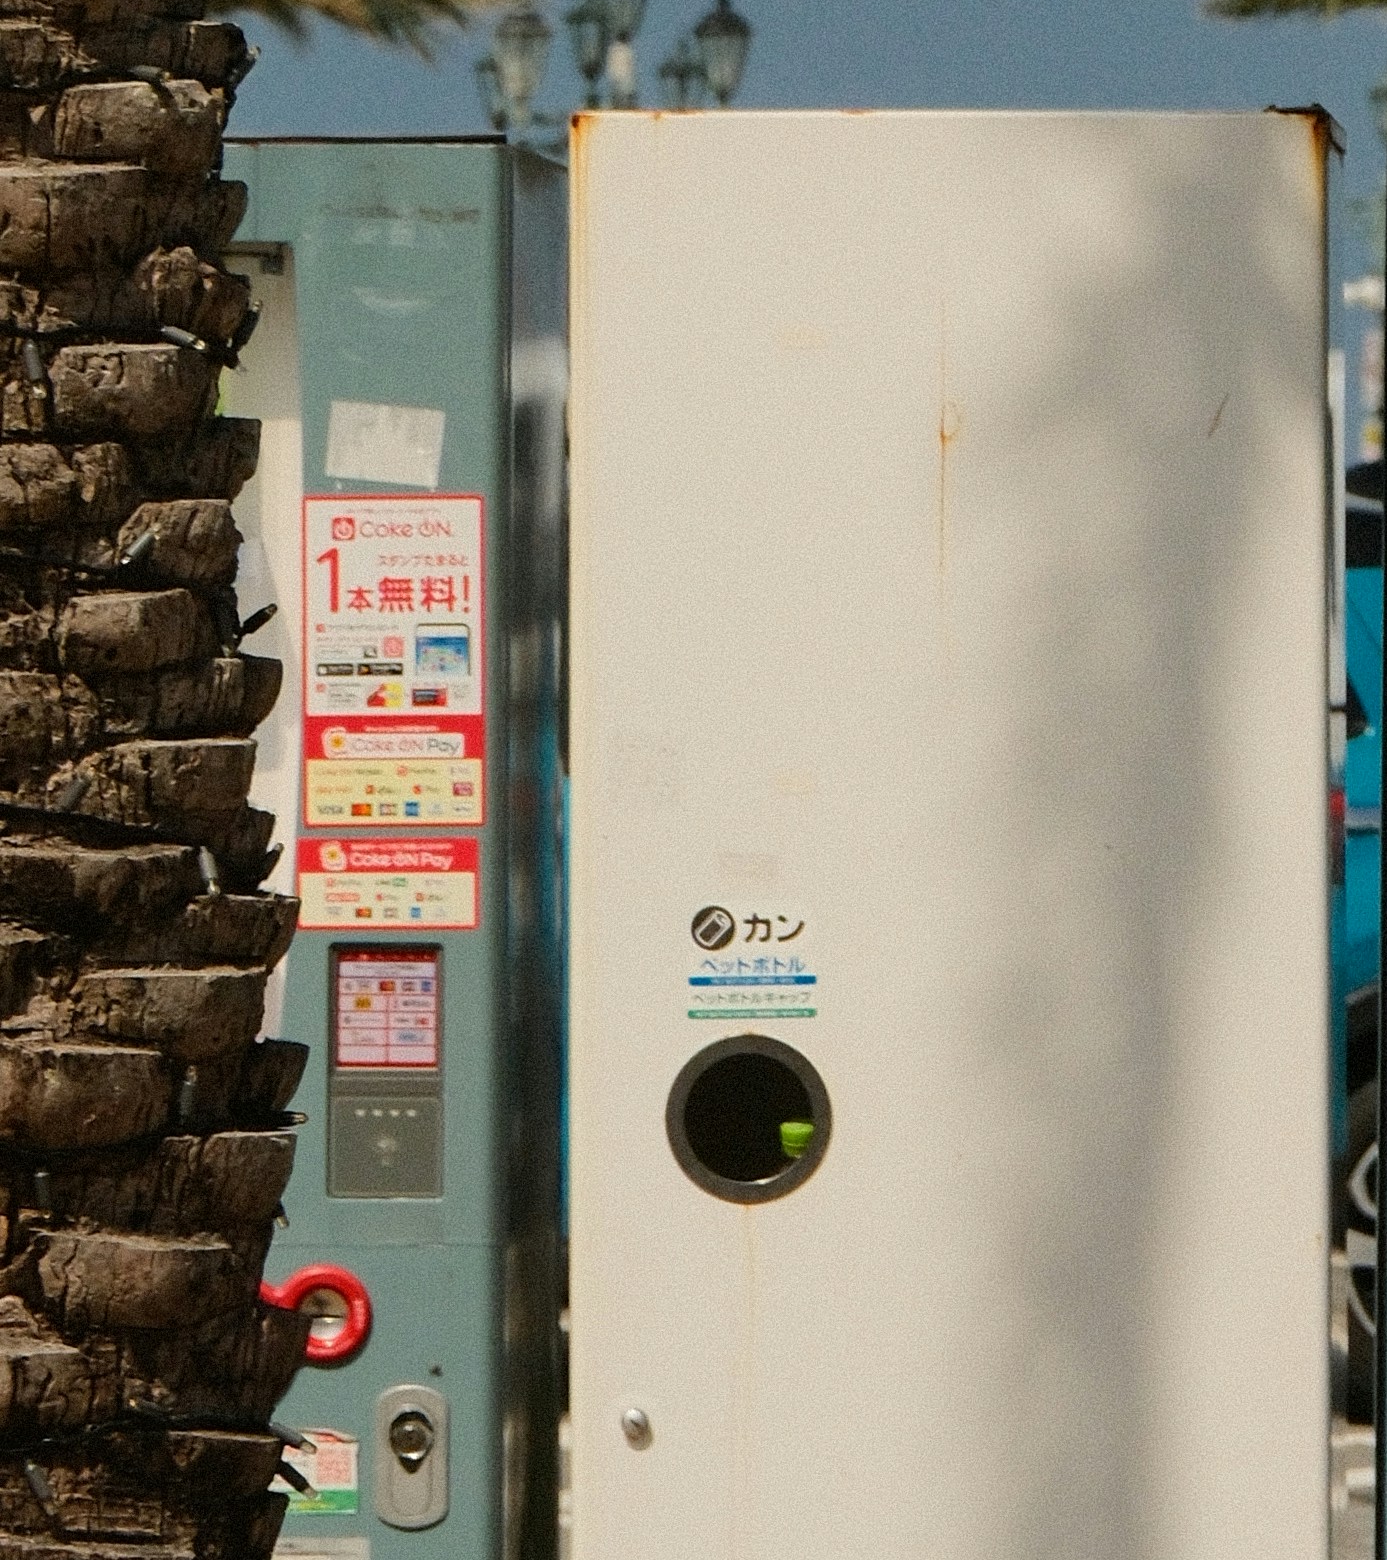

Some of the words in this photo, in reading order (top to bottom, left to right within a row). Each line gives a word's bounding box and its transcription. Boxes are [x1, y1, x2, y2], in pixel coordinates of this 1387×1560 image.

[359, 519, 413, 539] Coke
[426, 737, 462, 757] Pay
[743, 913, 805, 943] カン
